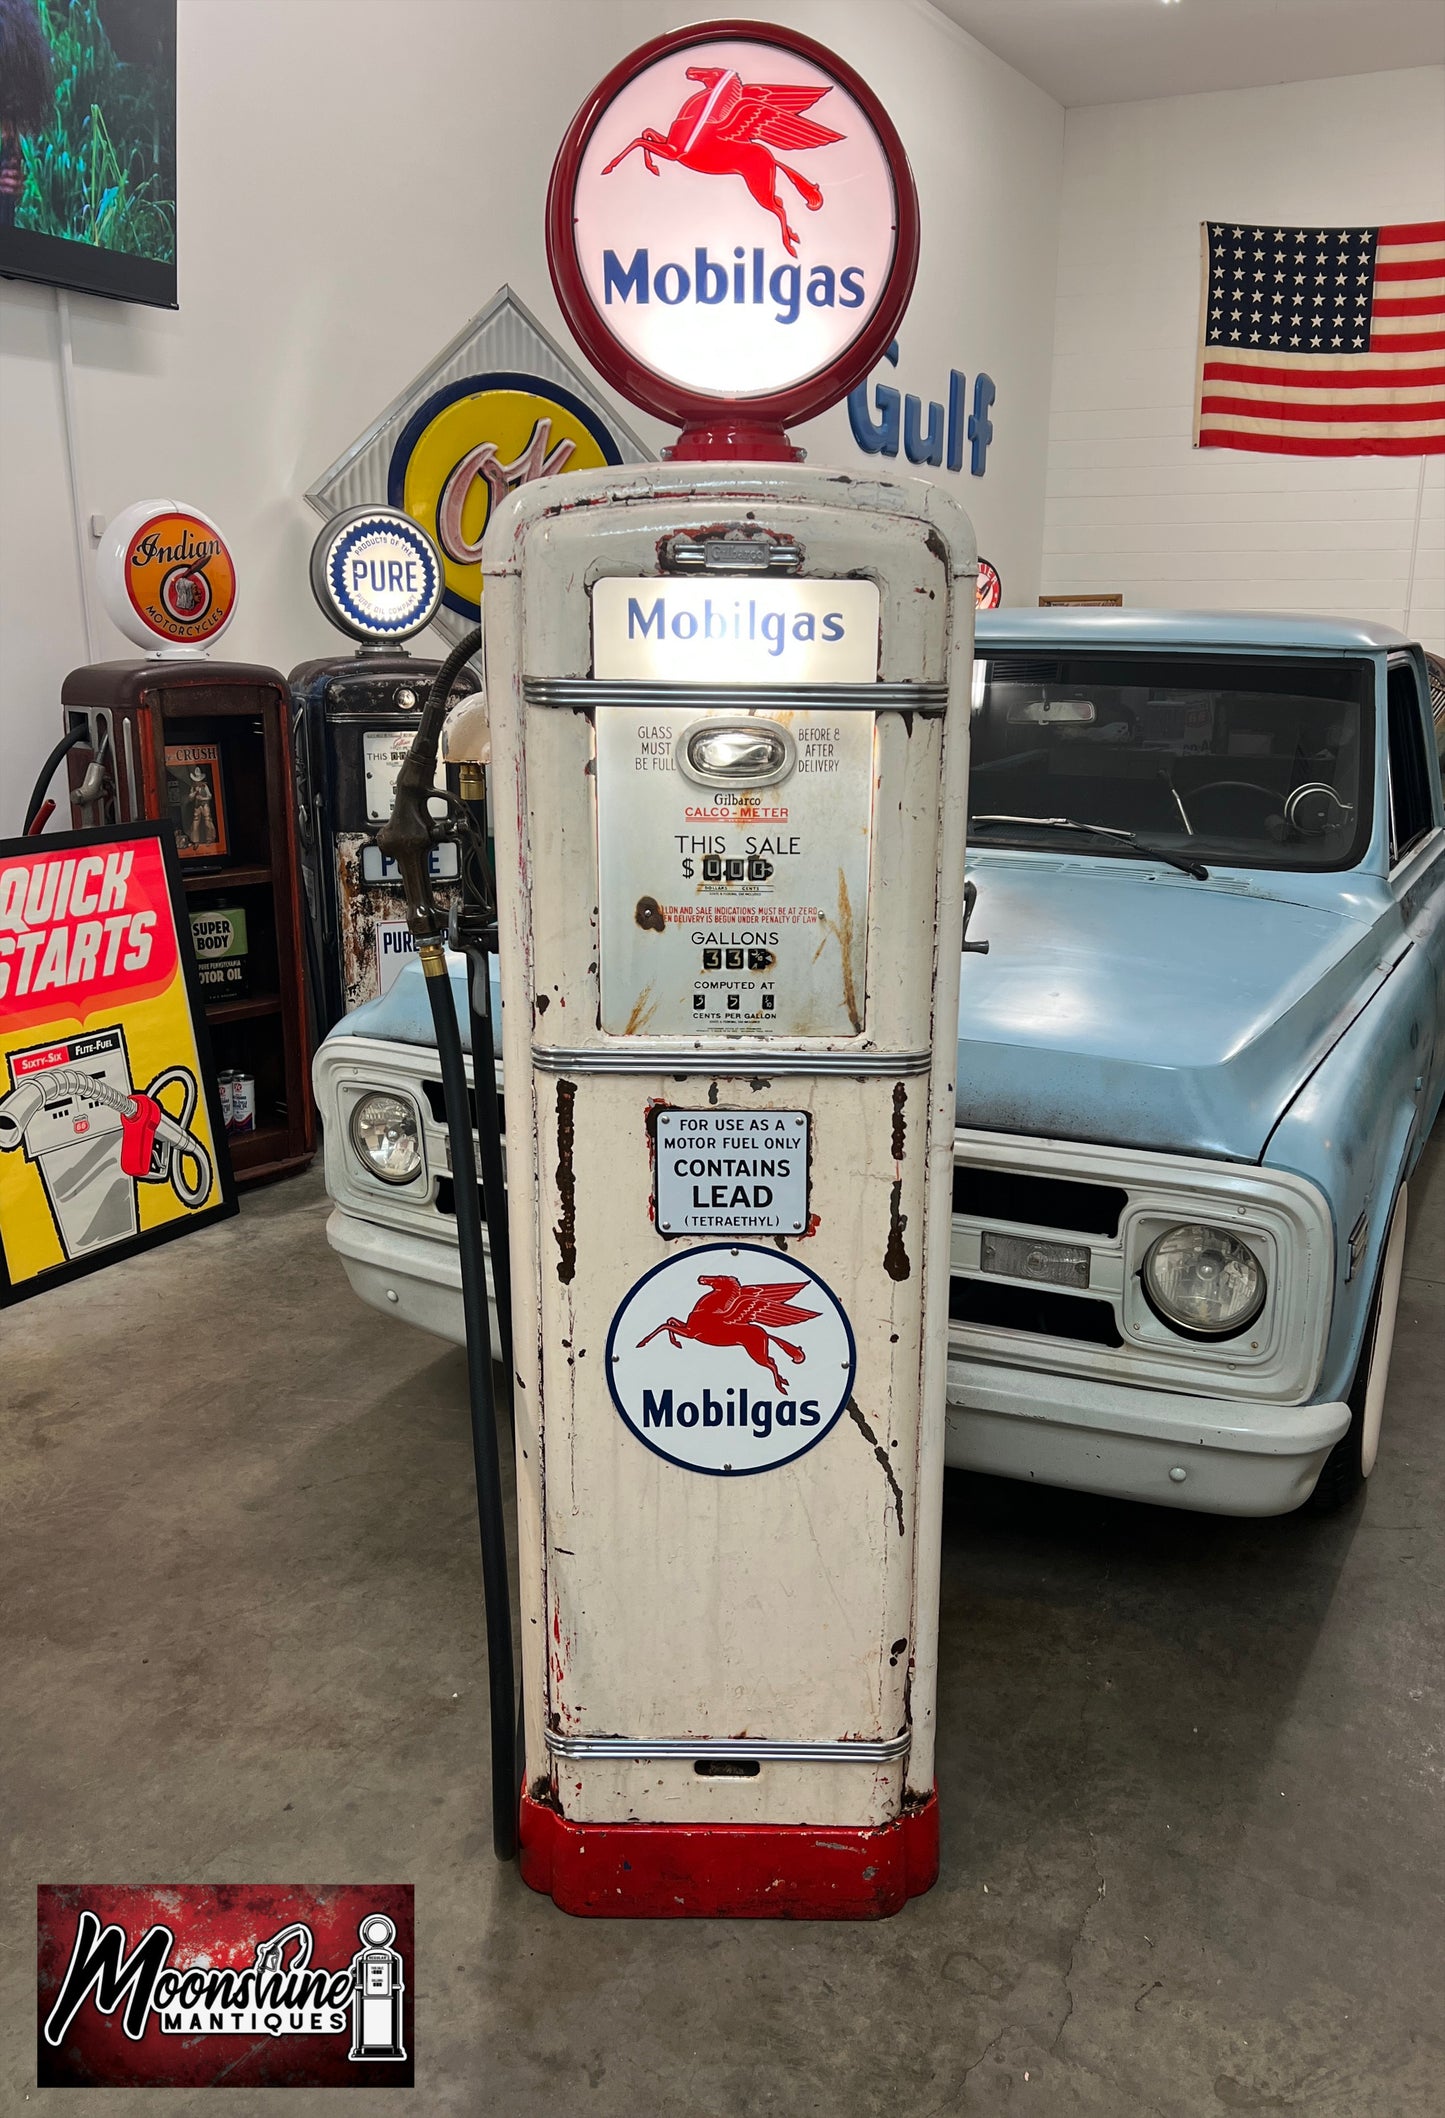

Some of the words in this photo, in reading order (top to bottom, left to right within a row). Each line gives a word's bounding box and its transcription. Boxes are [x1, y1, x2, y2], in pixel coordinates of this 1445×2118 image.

[602, 246, 866, 325] Mobilgas
[847, 338, 996, 477] Gulf
[131, 530, 221, 566] Indian
[354, 537, 387, 556] PRODUCTS
[401, 542, 414, 557] THE
[352, 560, 418, 592] PURE
[356, 593, 371, 609] PURE
[373, 606, 386, 615] OIL
[388, 595, 416, 615] COMPANY
[146, 605, 224, 636] MOTORCYCLES
[627, 597, 845, 657] Mobilgas
[637, 726, 673, 739] GLASS
[798, 728, 831, 741] BEFORE
[176, 747, 217, 761] CRUSH
[367, 752, 388, 760] THIS
[641, 742, 671, 755] MUST
[805, 744, 834, 757] AFTER
[635, 758, 649, 771] BE
[652, 757, 676, 771] FULL
[798, 760, 840, 773] DELIVERY
[714, 793, 761, 807] Gilbarco
[675, 836, 726, 854] THIS
[745, 837, 801, 855] SALE
[382, 847, 440, 876] PE
[682, 858, 694, 879] $
[0, 850, 134, 933] QUICK
[680, 906, 693, 914] AND
[696, 906, 712, 914] SALE
[715, 906, 756, 915] INDICATIONS
[758, 907, 777, 915] MUST
[778, 907, 786, 915] BE
[788, 907, 796, 915] AT
[799, 907, 817, 915] ZERO
[674, 915, 704, 923] DELIVERY
[706, 915, 713, 923] IS
[714, 915, 736, 923] BEGUN
[738, 915, 759, 923] UNDER
[193, 920, 231, 936] SUPER
[197, 935, 229, 950] BODY
[692, 932, 779, 945] GALLONS
[199, 970, 224, 984] OTOR
[227, 968, 242, 980] OIL
[694, 981, 755, 989] COMPUTED
[760, 981, 775, 989] AT
[22, 1053, 62, 1070] SIXTY-SIX
[75, 1039, 113, 1056] FLITE-FUEL
[76, 1122, 86, 1131] 66
[680, 1119, 708, 1131] FOR
[715, 1120, 744, 1131] USE
[750, 1120, 770, 1131] AS
[774, 1120, 785, 1131] A
[664, 1138, 716, 1149] MOTOR
[723, 1138, 759, 1149] FUEL
[764, 1138, 801, 1149] ONLY
[673, 1159, 791, 1177] CONTAINS
[692, 1185, 774, 1208] LEAD
[684, 1216, 780, 1227] (TETRAETHYL)
[642, 1388, 821, 1438] Mobilgas
